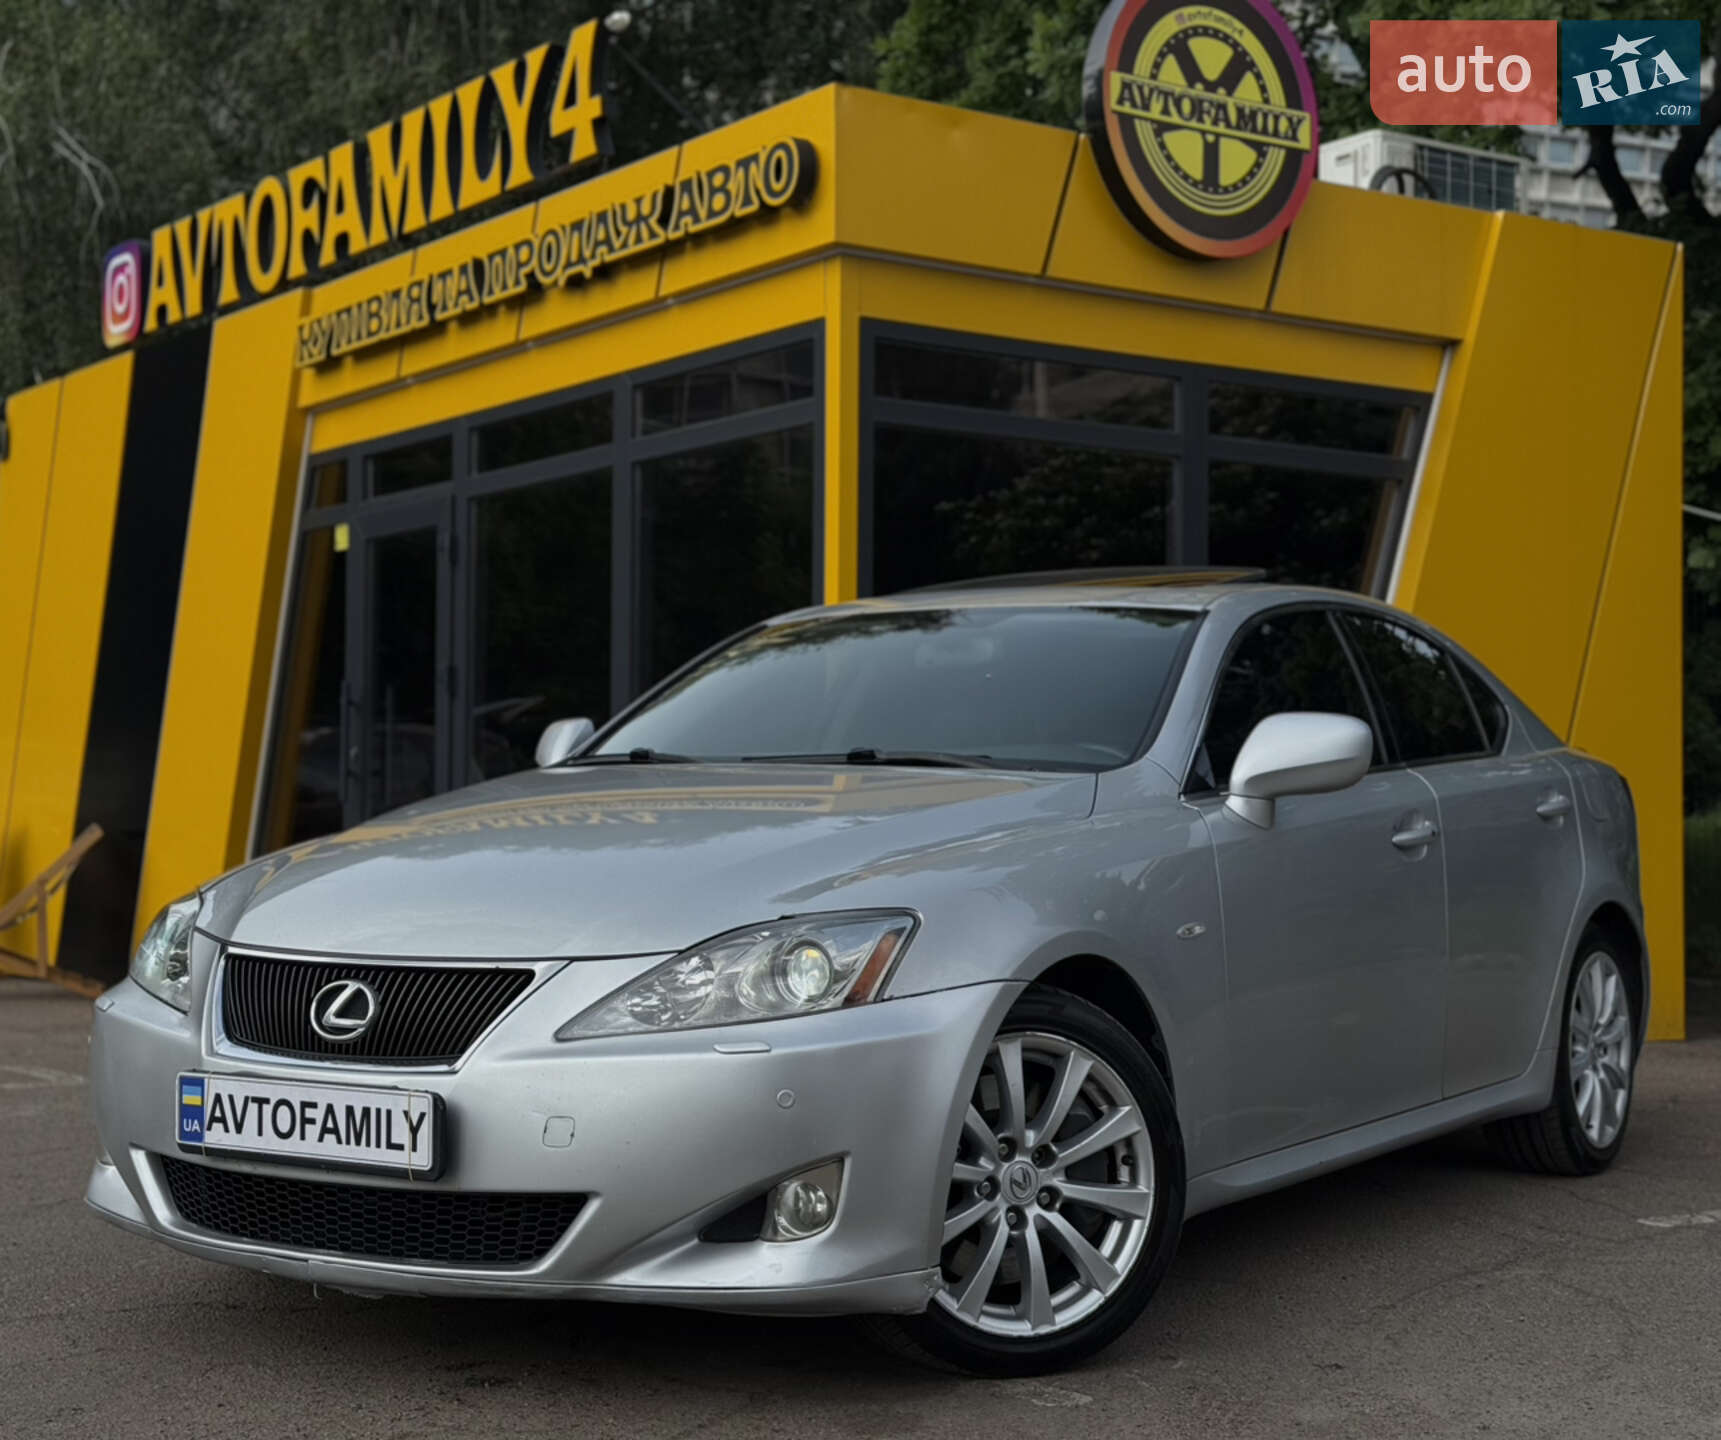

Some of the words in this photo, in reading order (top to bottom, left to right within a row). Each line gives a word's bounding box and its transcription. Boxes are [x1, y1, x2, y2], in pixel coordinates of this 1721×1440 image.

[1117, 80, 1306, 143] AVTOFAMILY
[144, 18, 603, 333] AVTOFAMILY4
[296, 274, 431, 367] КУПІВЛЯ
[430, 260, 481, 321] ТА
[480, 189, 667, 304] ПРОДАЖ
[667, 137, 799, 241] АВТО
[182, 1117, 202, 1133] UA
[206, 1092, 427, 1153] AVTOFAMILY
